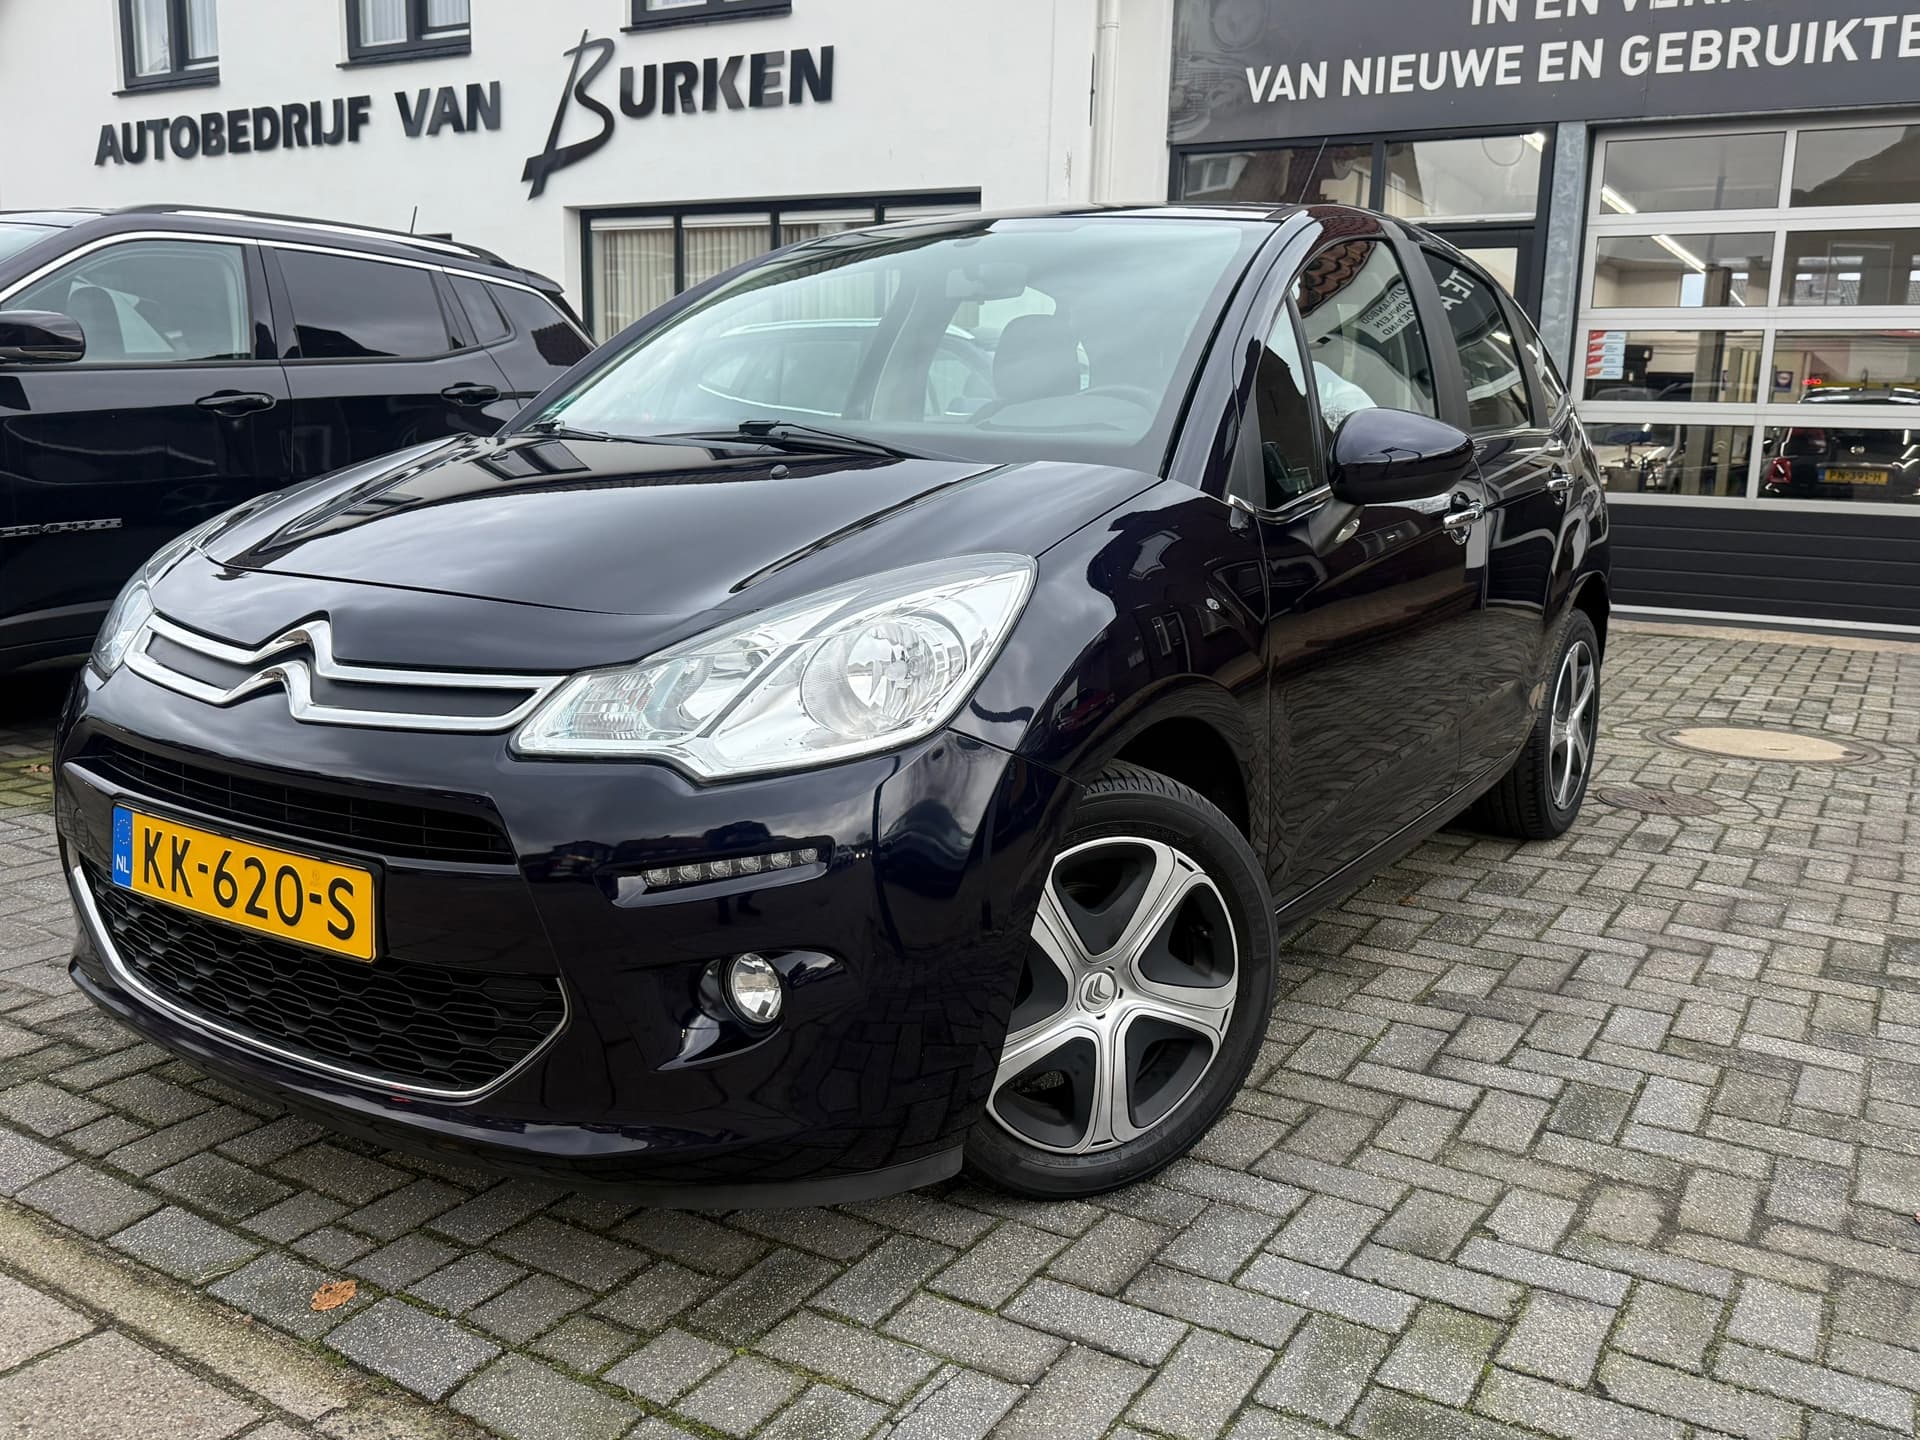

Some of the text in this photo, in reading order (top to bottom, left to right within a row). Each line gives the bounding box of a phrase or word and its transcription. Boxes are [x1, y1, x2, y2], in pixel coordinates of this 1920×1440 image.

[1245, 13, 1920, 104] VAN NIEUWE EN GEBRUIKTE
[1470, 0, 1520, 26] IN
[94, 28, 836, 201] AUTOBEDRIJF VAN BURKEN
[116, 853, 131, 875] NL
[143, 826, 356, 941] KK-620-S
